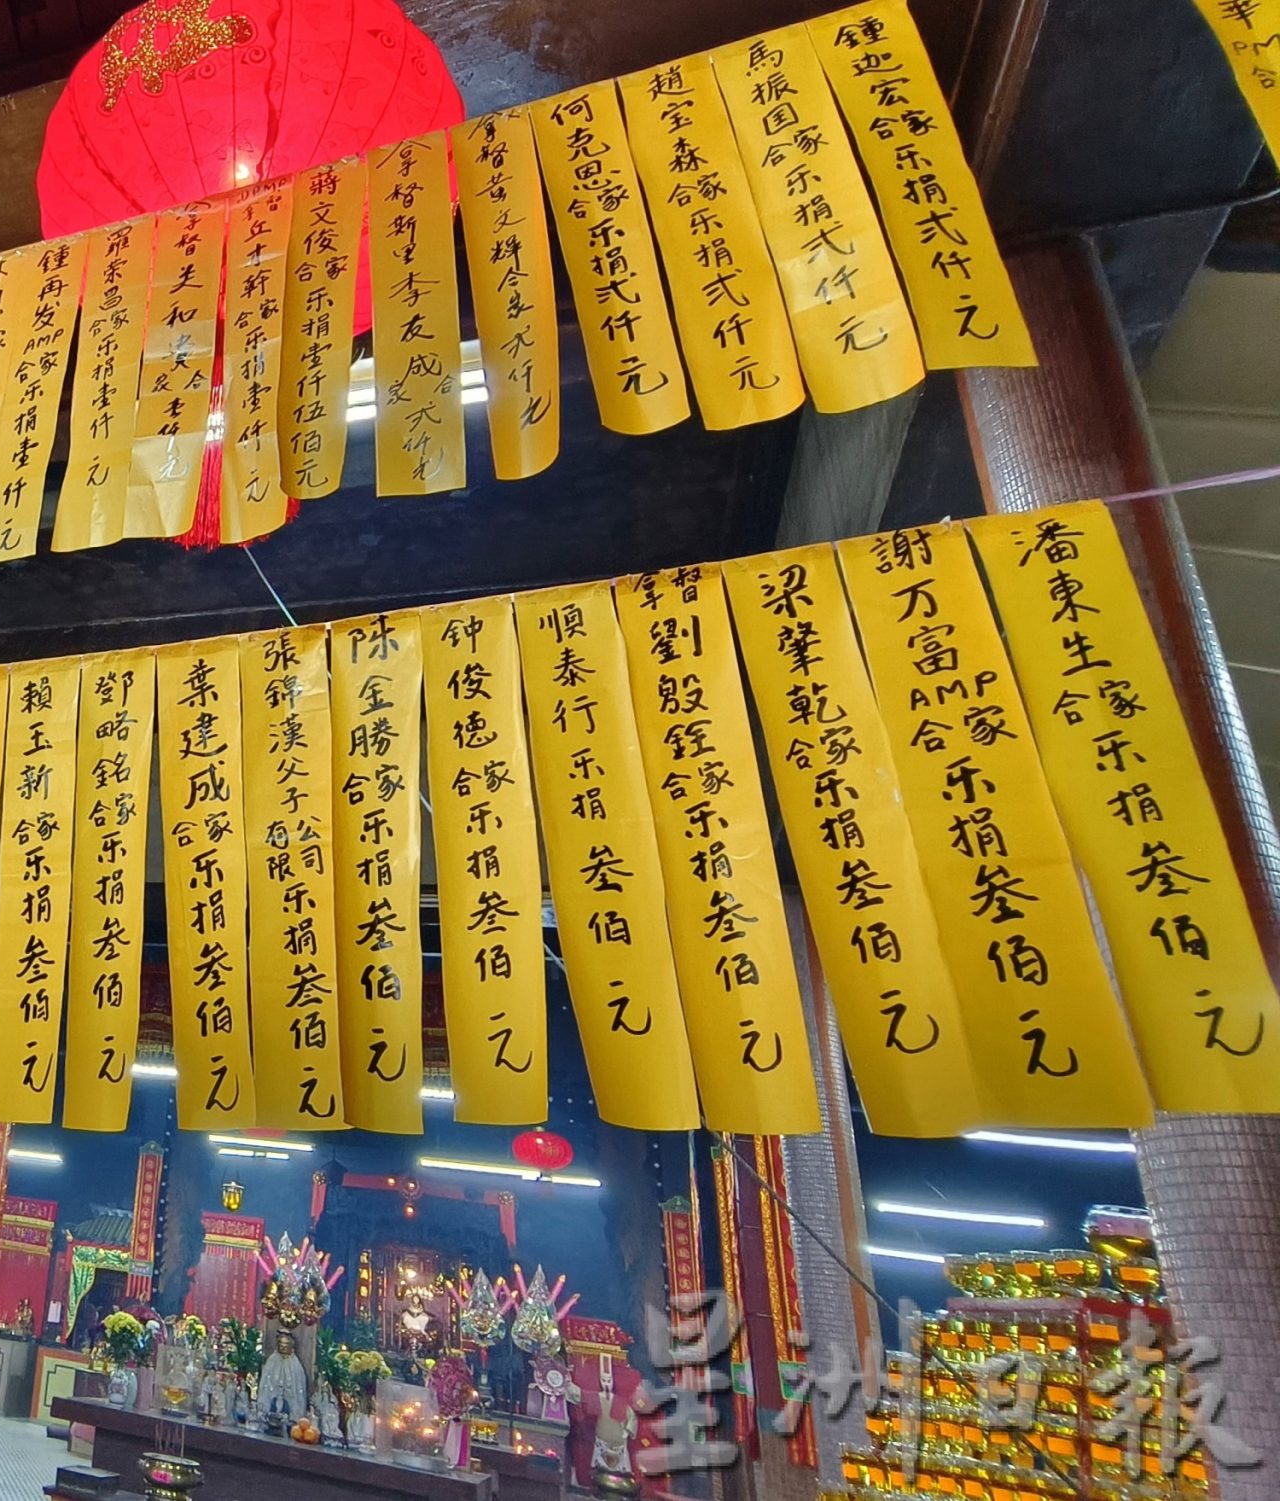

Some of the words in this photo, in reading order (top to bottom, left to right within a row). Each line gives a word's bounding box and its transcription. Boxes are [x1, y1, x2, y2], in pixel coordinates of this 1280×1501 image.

[538, 605, 652, 1036] 順泰行乐捐叁佰元
[1014, 519, 1264, 1056] 潘東生合家乐捐叁佰元
